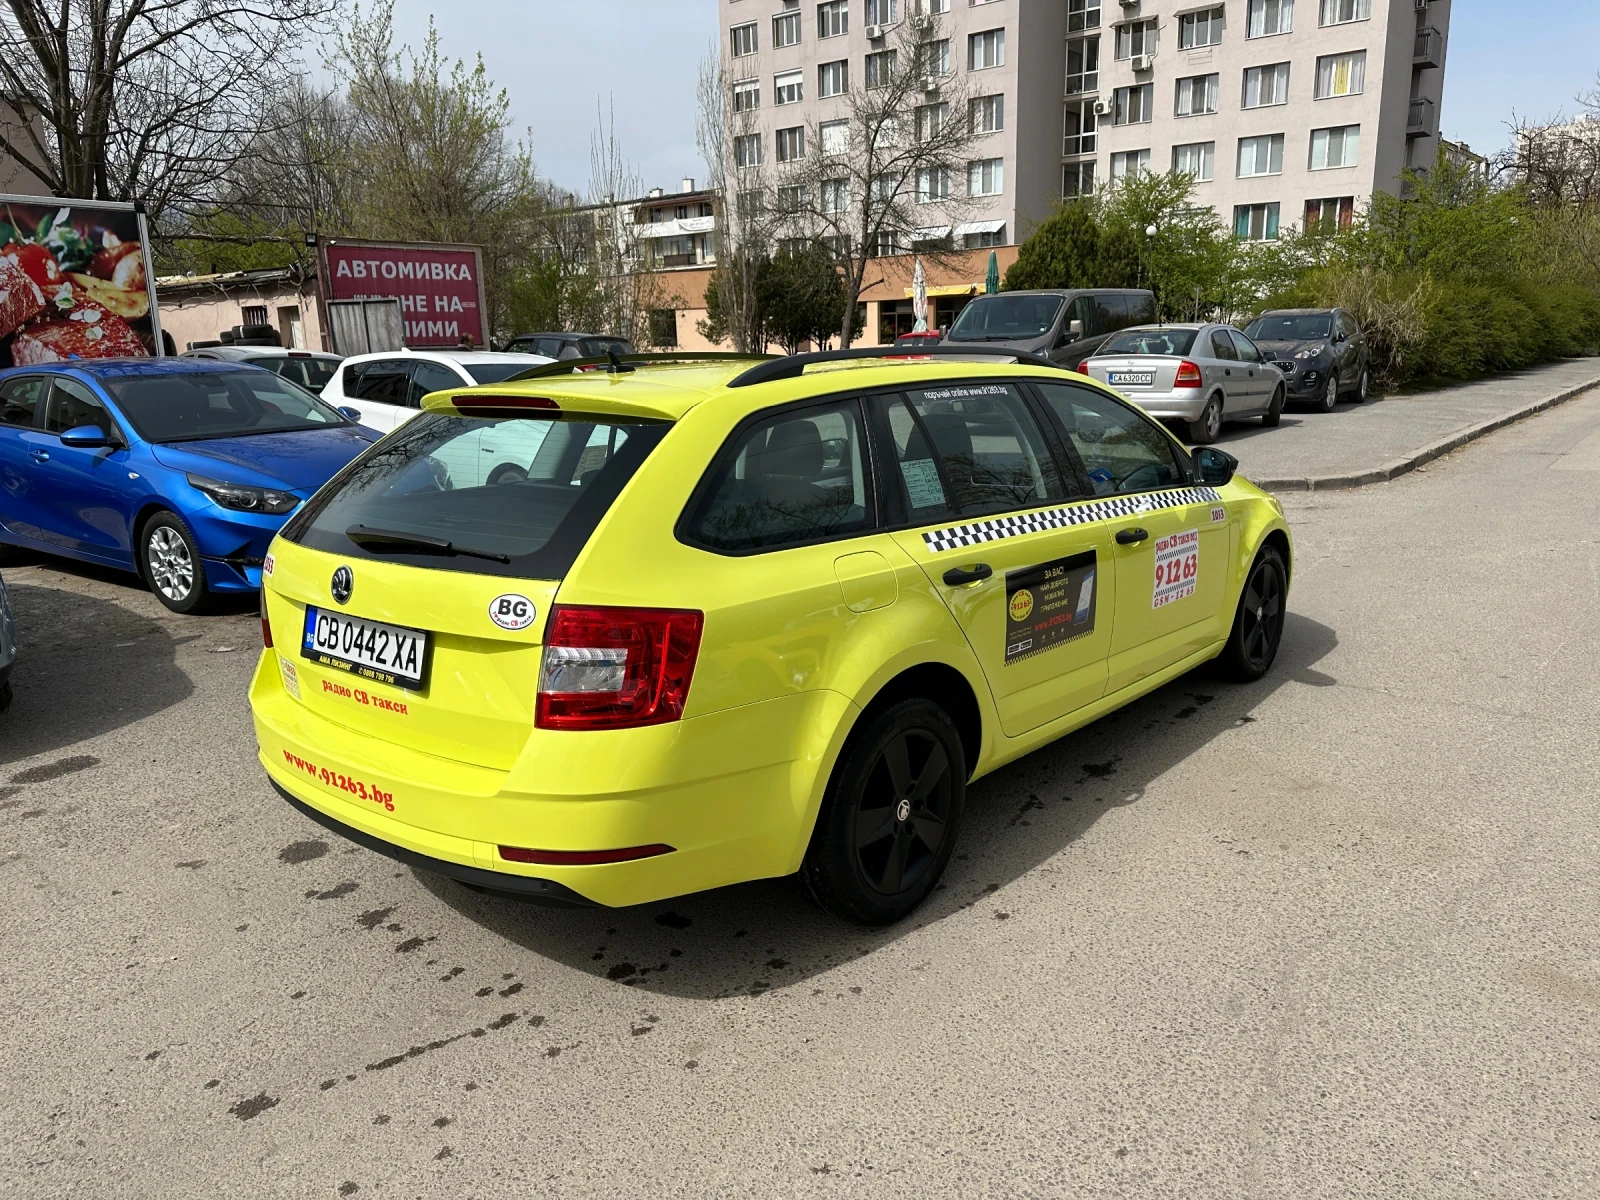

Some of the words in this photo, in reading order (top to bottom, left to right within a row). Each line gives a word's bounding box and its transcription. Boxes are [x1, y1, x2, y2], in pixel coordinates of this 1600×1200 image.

[336, 259, 472, 281] АВТОМИВКА
[434, 295, 464, 313] НА
[1113, 374, 1123, 383] CA
[1123, 374, 1140, 382] 6320
[1140, 374, 1150, 382] CC
[951, 388, 969, 397] online
[968, 385, 1008, 395] www.91263.bg
[1155, 540, 1169, 555] радио
[1169, 534, 1178, 548] СВ
[1178, 532, 1190, 545] такси
[1044, 570, 1052, 580] ЗА
[1052, 566, 1065, 576] ВАС!
[1040, 577, 1068, 591] НАЙ-ДОБРОТО
[1044, 589, 1065, 601] МОБИЛНО
[498, 598, 528, 618] BG
[1040, 598, 1068, 613] ПРИЛОЖЕНИЕ
[307, 632, 315, 643] BG
[316, 615, 340, 650] CB
[343, 622, 390, 664] 0442
[391, 633, 417, 674] XA
[331, 659, 353, 671] ЛИЗИНГ
[322, 679, 352, 698] радио
[353, 688, 370, 705] СВ
[371, 695, 408, 715] такси
[283, 749, 395, 812] www.91263.bg
